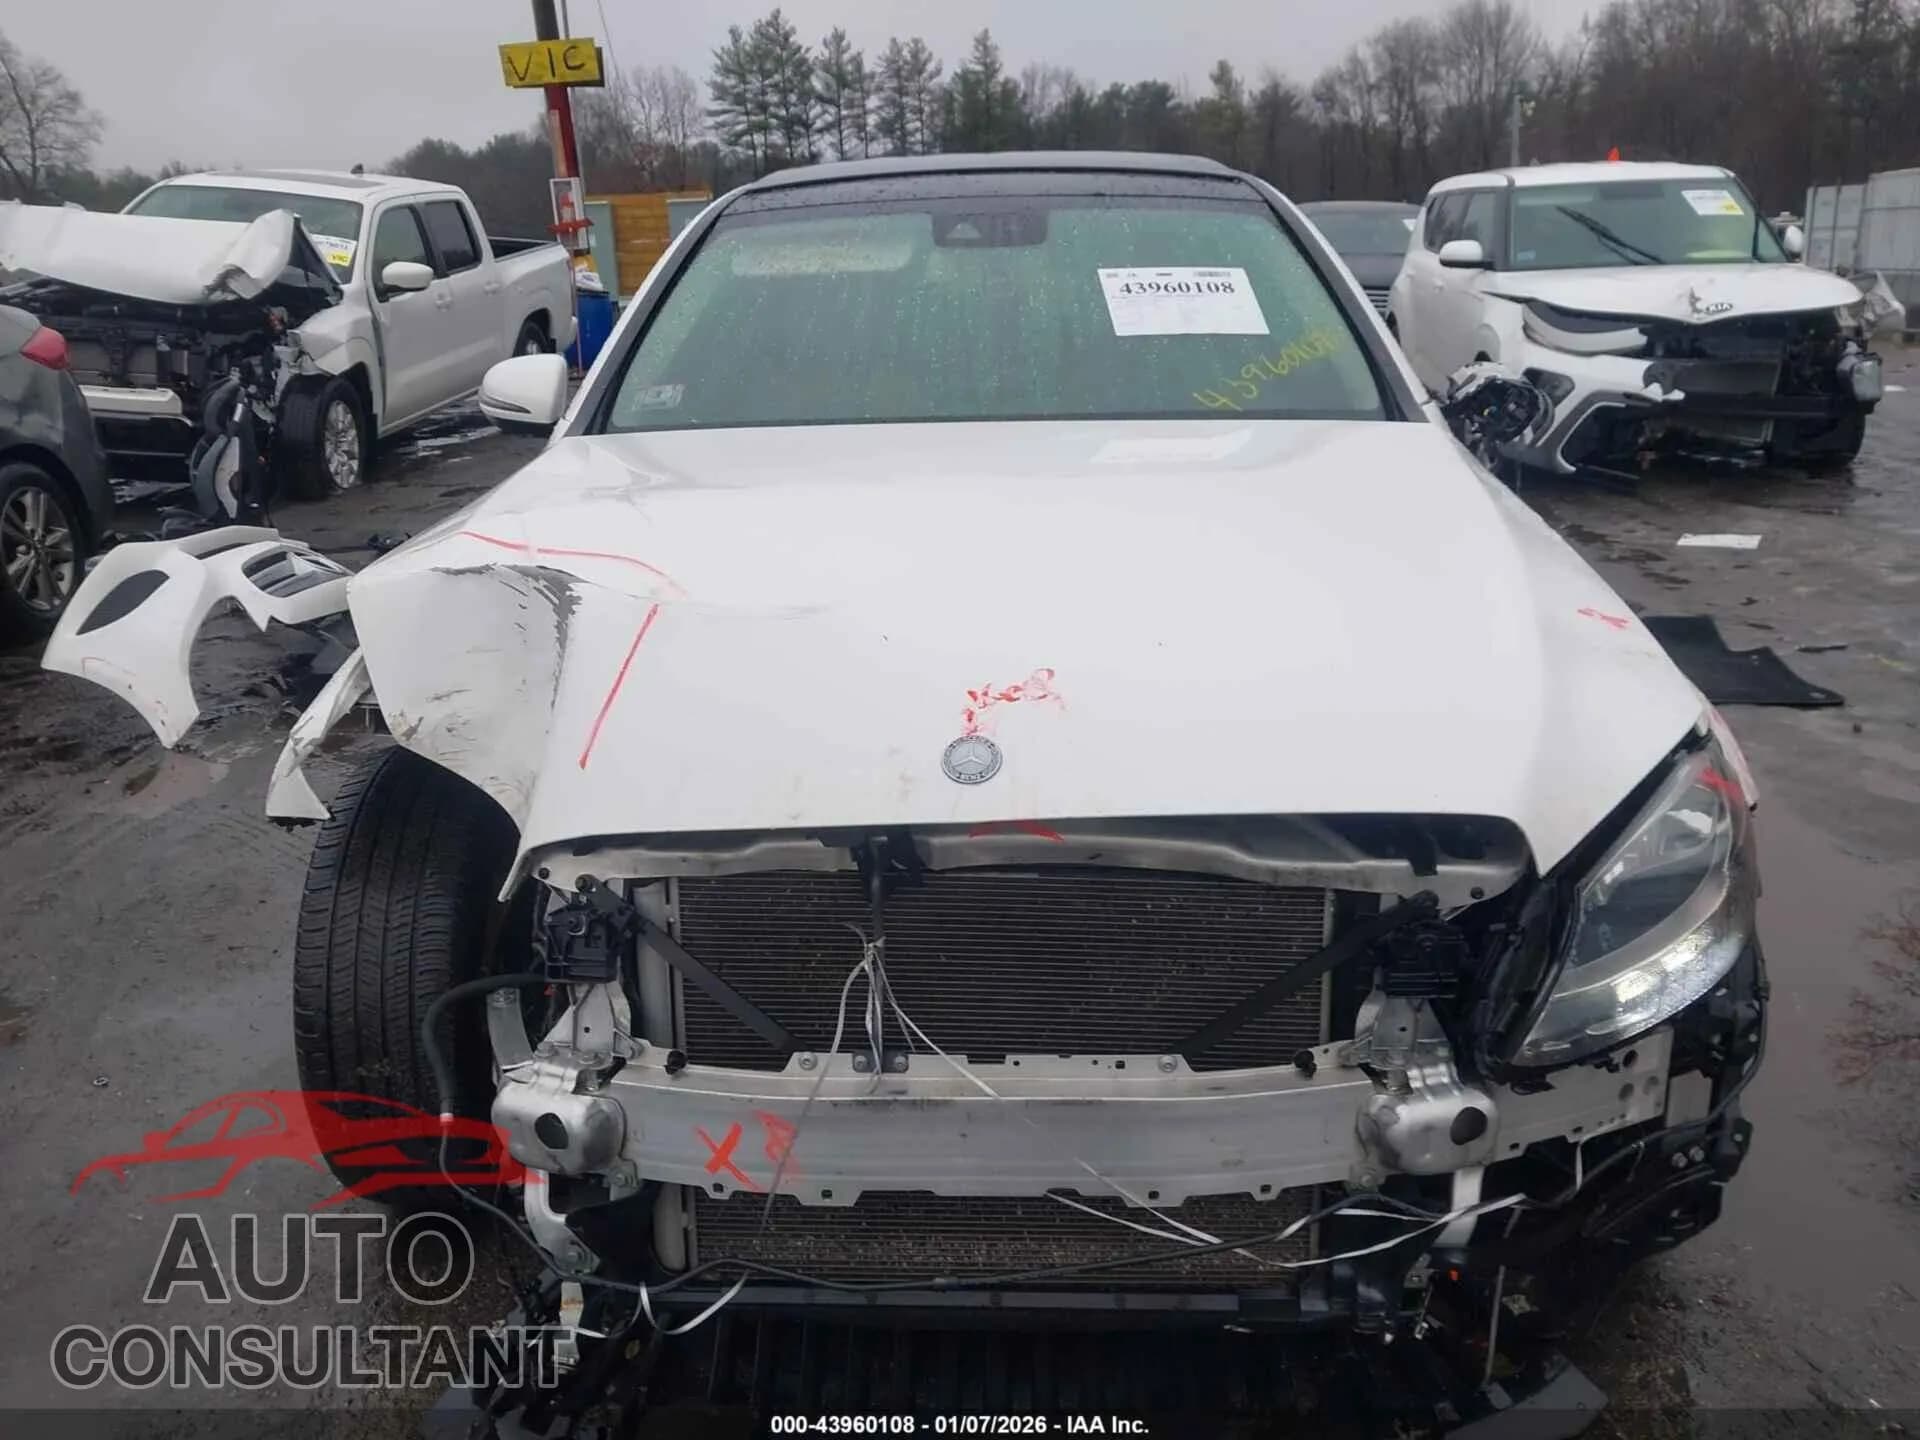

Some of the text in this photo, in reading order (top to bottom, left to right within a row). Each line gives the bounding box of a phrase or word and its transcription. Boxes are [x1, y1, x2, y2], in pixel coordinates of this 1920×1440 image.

[507, 45, 585, 82] VIC
[1119, 281, 1236, 295] 43960108
[1707, 303, 1731, 313] KIA
